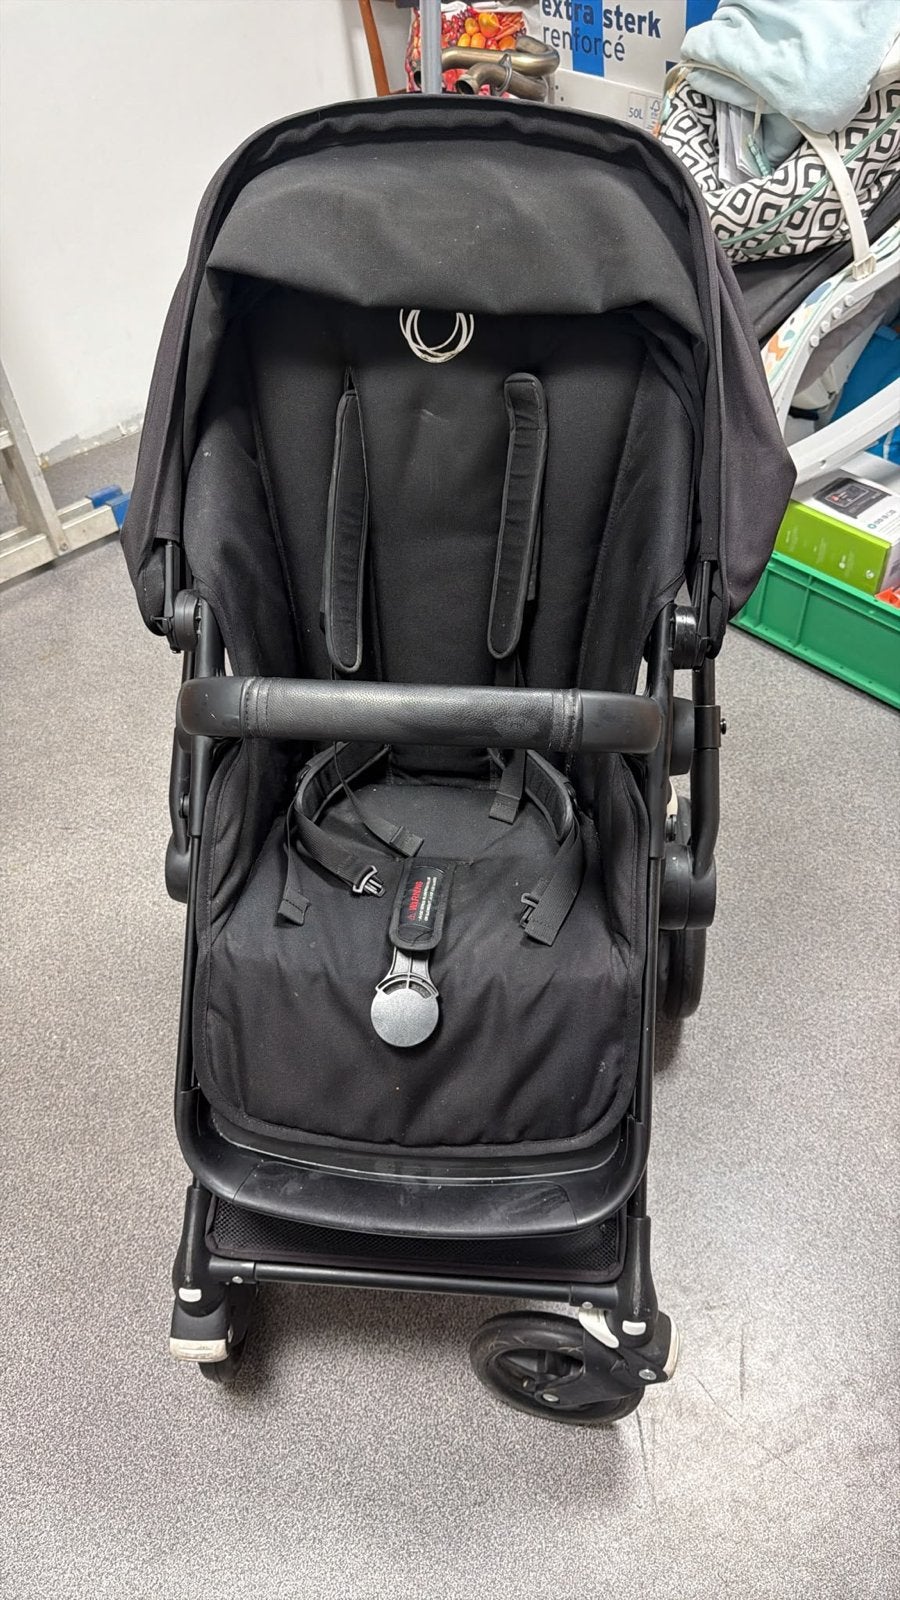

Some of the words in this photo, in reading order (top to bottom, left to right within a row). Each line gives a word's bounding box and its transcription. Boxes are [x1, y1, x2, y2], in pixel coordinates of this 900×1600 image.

[541, 0, 594, 26] extra
[602, 4, 662, 39] sterk
[542, 26, 625, 62] renforcé
[628, 107, 643, 120] 50L
